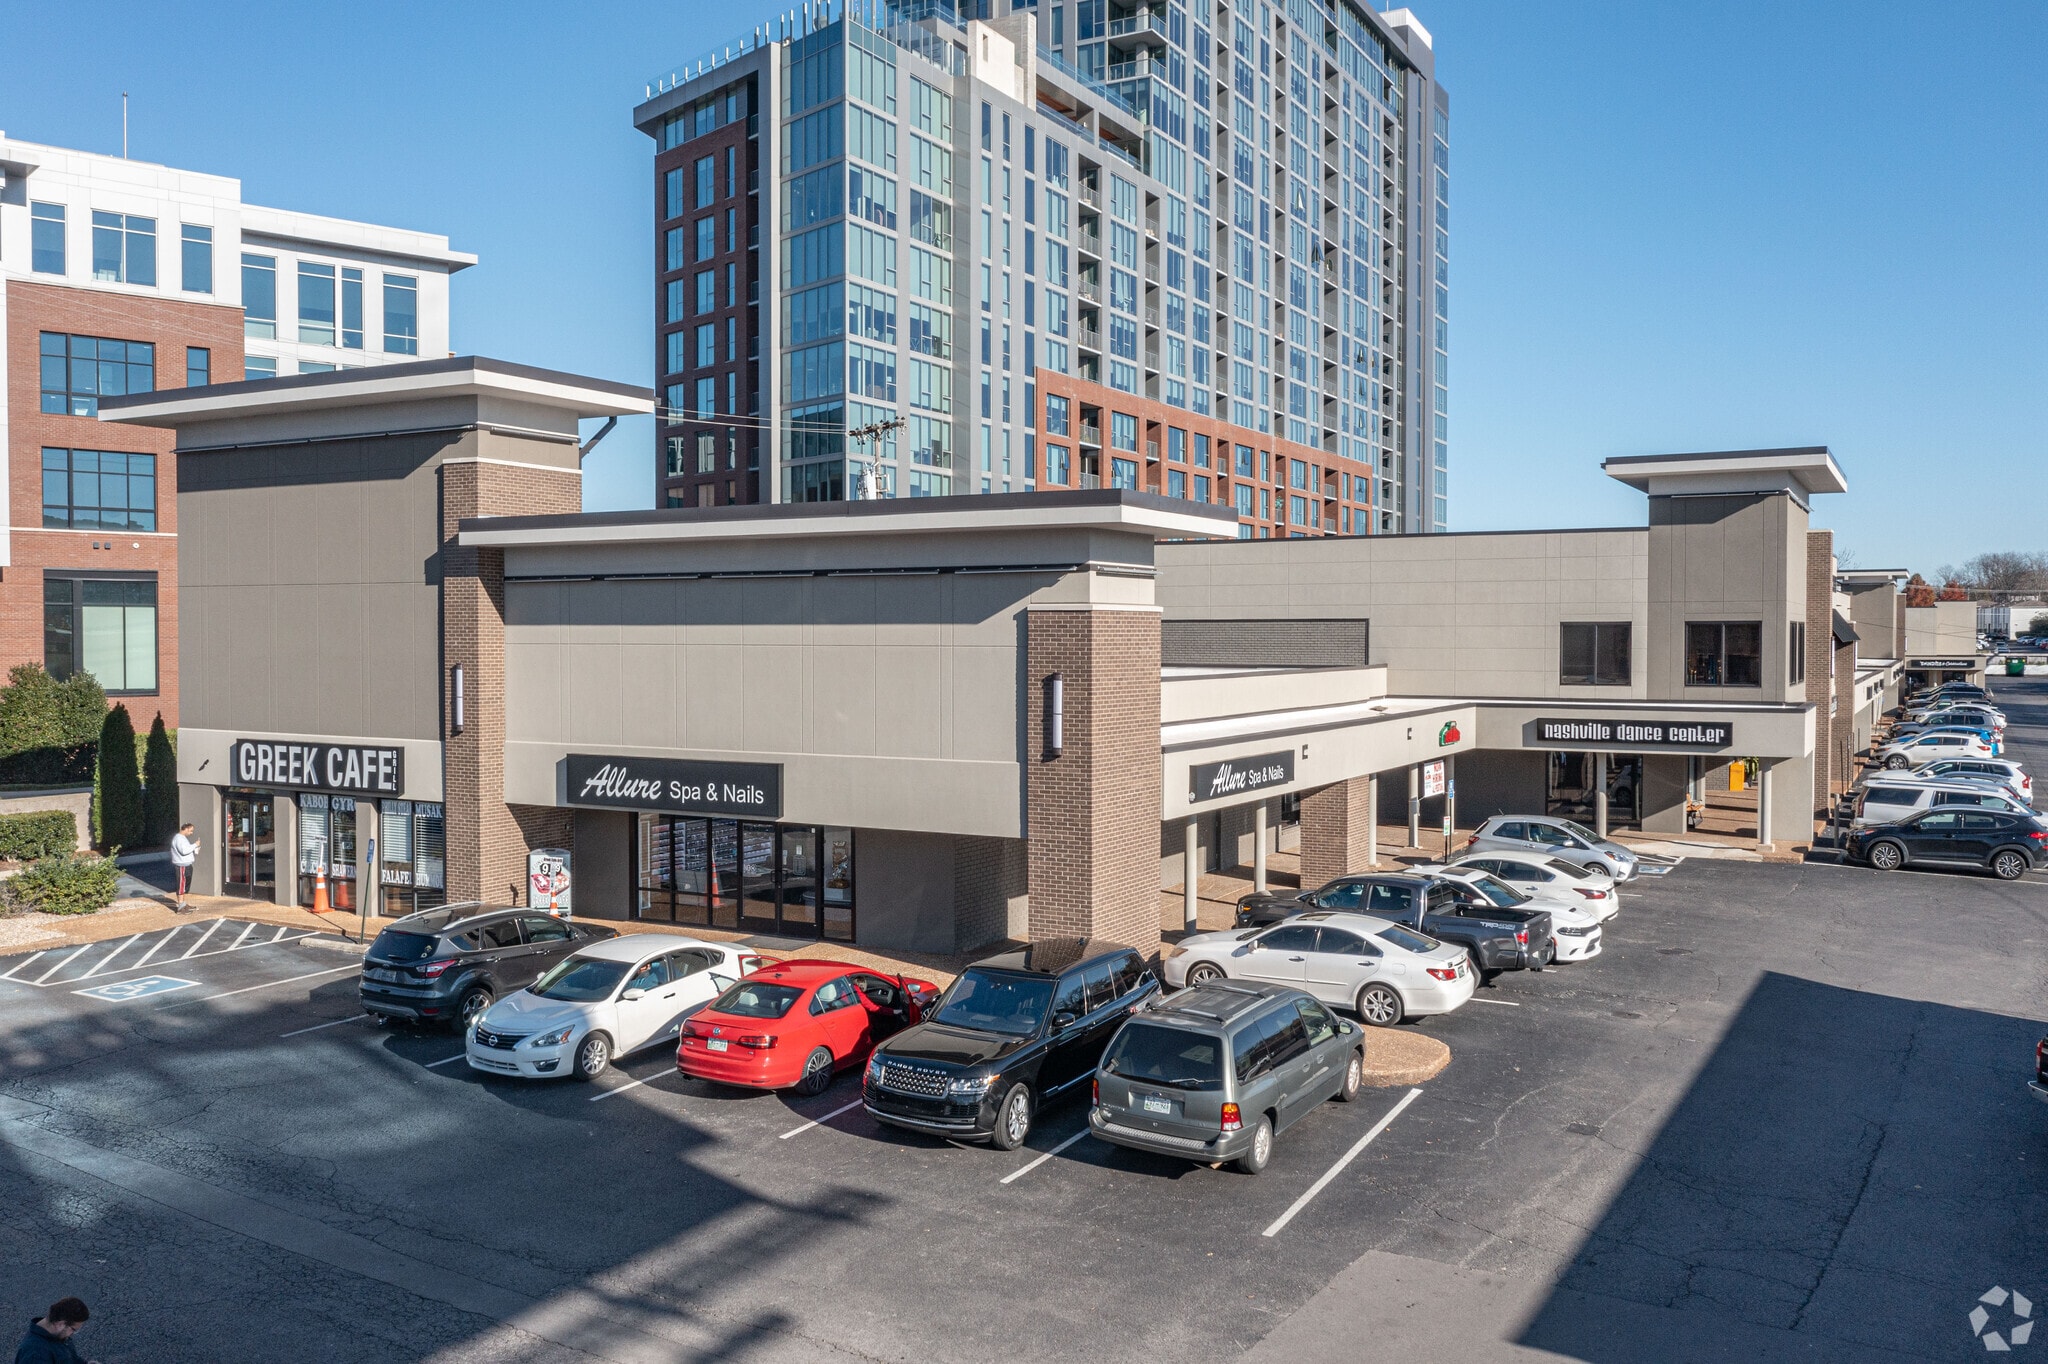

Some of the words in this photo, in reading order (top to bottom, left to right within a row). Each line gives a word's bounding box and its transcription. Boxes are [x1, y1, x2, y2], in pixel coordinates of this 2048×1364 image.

[1544, 722, 1610, 739] nashville
[1616, 724, 1662, 741] dance
[1669, 725, 1725, 743] center
[239, 742, 320, 785] GREEK
[327, 747, 392, 791] CAFE
[580, 763, 662, 800] Allure
[669, 780, 701, 803] Spa
[706, 782, 718, 801] &
[723, 783, 764, 804] Nails
[1209, 763, 1247, 797] Allure
[1248, 769, 1262, 788] Spa
[1262, 767, 1268, 783] &
[1268, 764, 1284, 781] Nails
[331, 797, 356, 812] GYR
[541, 864, 561, 876] 9.9
[887, 1060, 914, 1070] RANGE
[917, 1067, 947, 1076] ROVER
